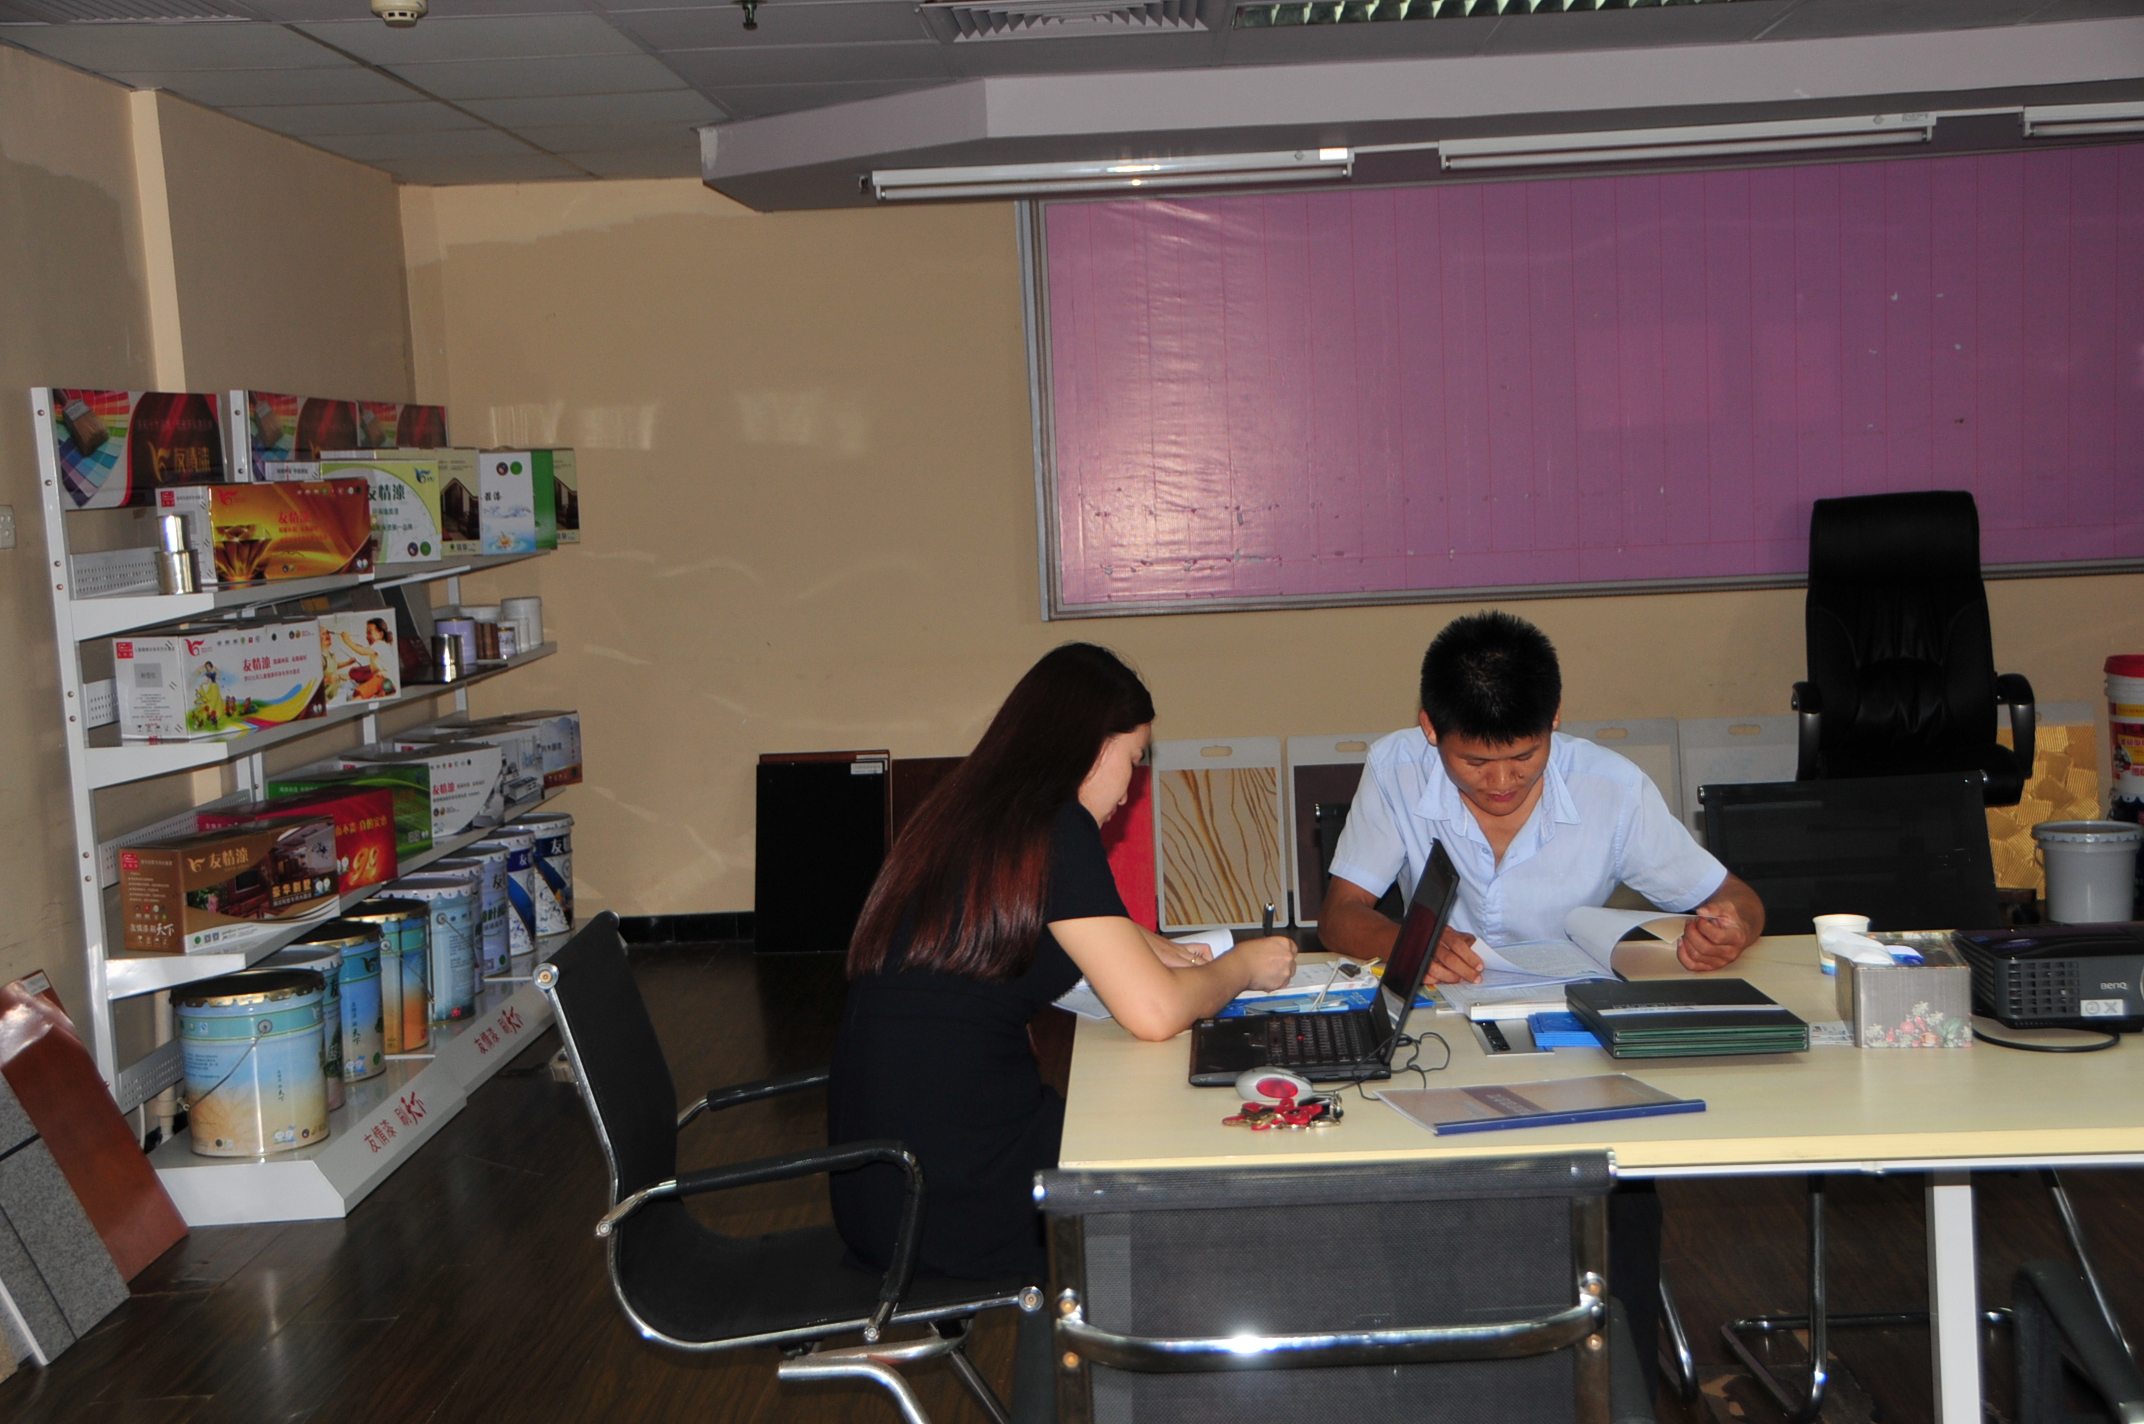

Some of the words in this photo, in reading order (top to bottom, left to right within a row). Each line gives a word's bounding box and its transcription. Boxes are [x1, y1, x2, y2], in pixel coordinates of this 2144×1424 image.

[243, 656, 271, 672] 友情漆
[432, 781, 455, 795] 友情漆
[209, 846, 249, 869] 友情漆
[474, 1027, 501, 1054] 友情漆
[363, 1119, 398, 1153] 友情漆
